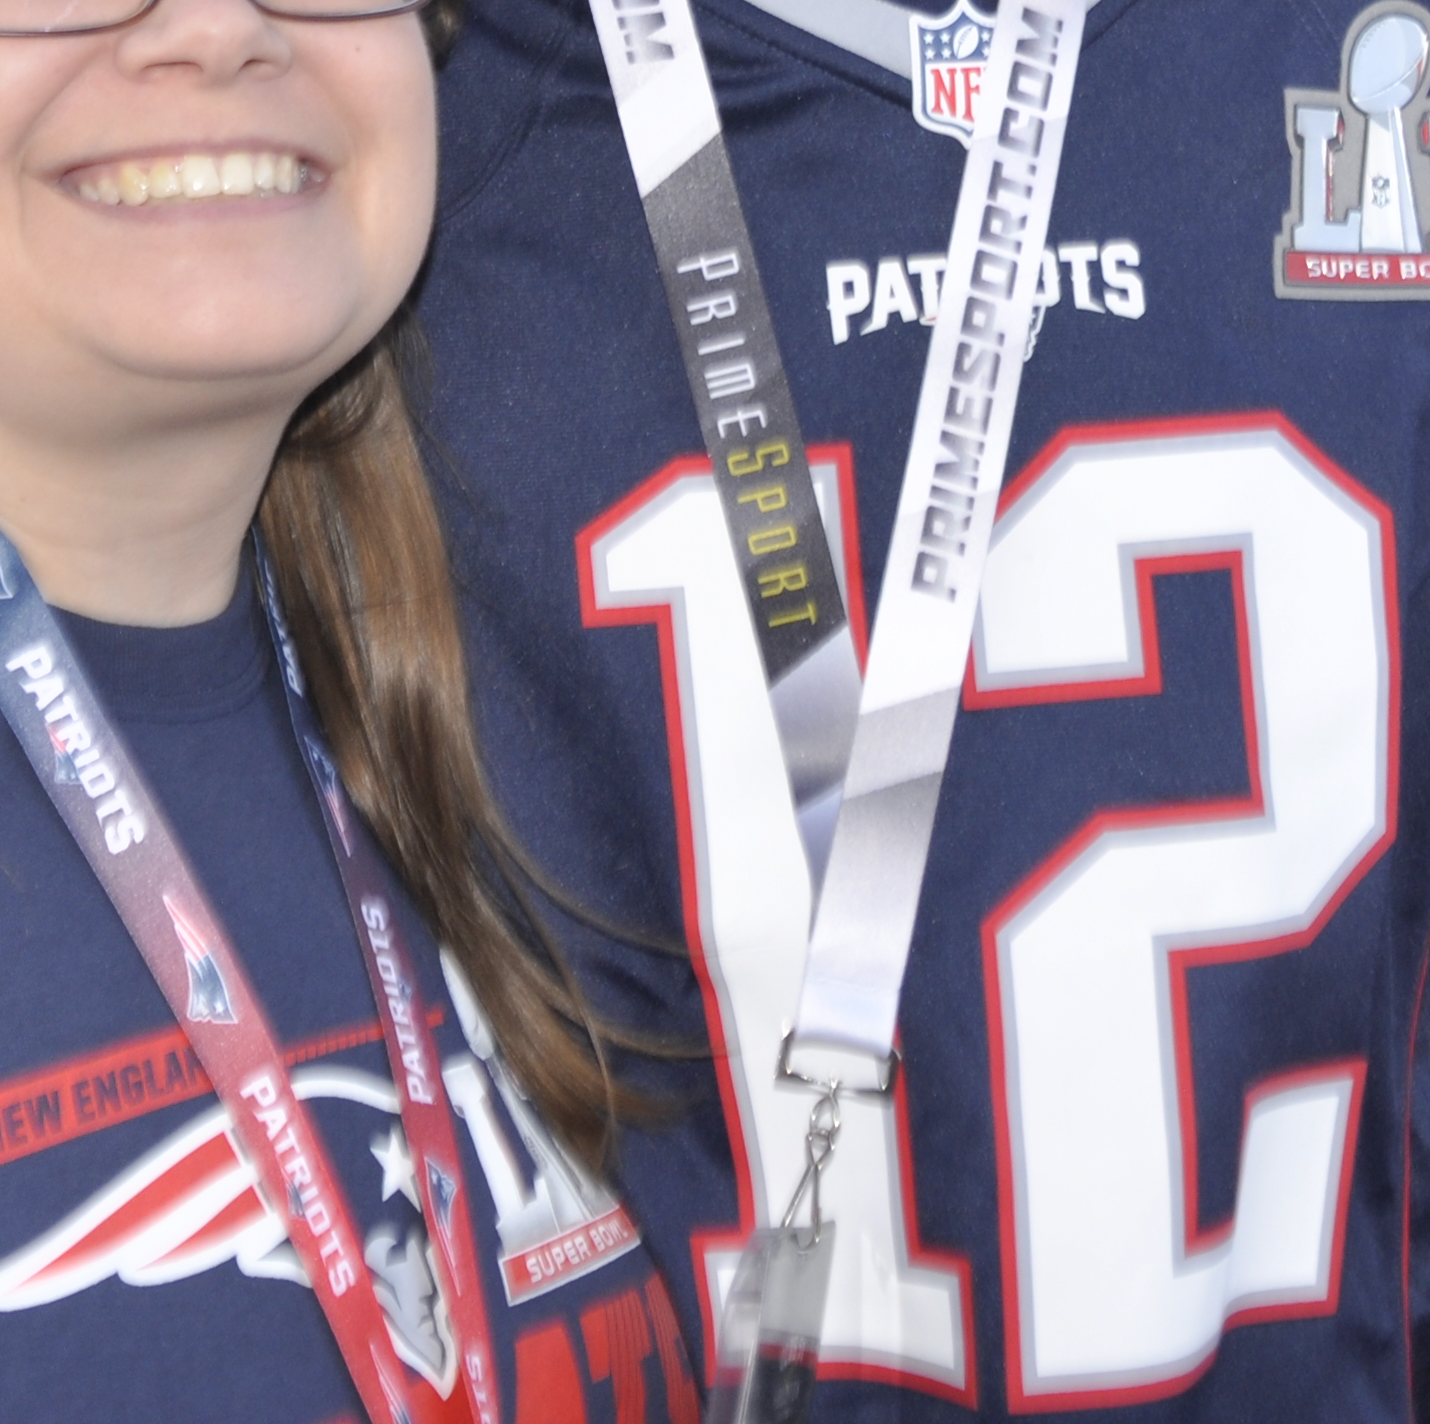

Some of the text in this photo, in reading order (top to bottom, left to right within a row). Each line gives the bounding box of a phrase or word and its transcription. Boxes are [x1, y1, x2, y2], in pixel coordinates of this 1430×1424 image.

[929, 65, 989, 124] NF
[825, 240, 1147, 347] PATOTS
[910, 6, 1064, 604] PRIMESPORT.COM
[1305, 256, 1390, 281] SUPER
[5, 643, 146, 856] PATRIOTS
[575, 408, 1401, 1416] 12
[361, 898, 436, 1106] PATRIOTS
[74, 1046, 211, 1126] ENGLAN
[238, 1070, 358, 1298] PATRIOTS
[525, 1218, 630, 1284] SUPER BOWL
